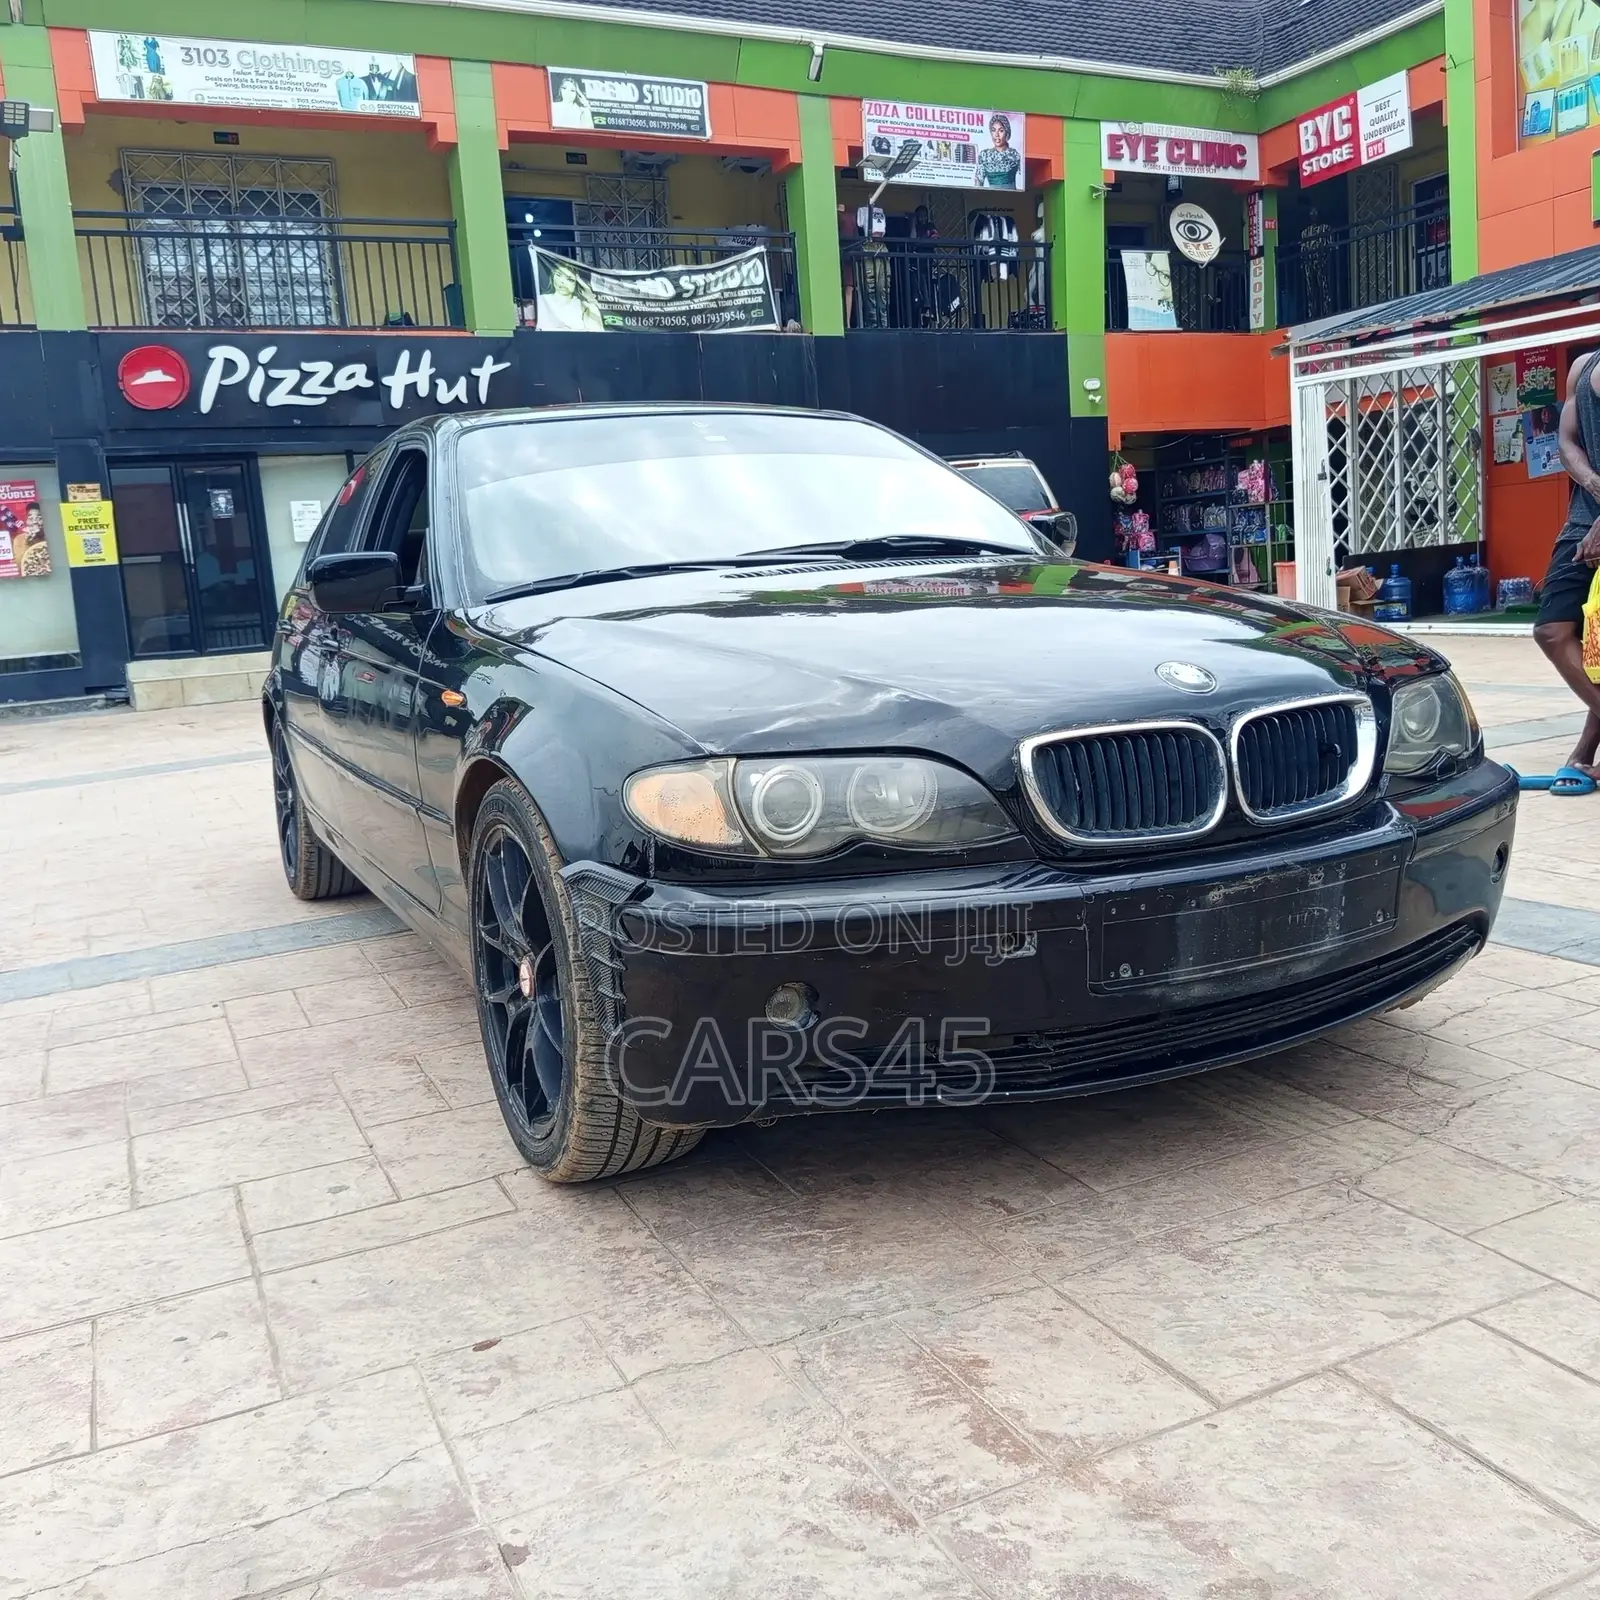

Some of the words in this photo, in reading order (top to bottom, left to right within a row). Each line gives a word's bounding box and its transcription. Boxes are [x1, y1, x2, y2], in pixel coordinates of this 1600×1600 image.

[180, 47, 231, 65] 3103
[236, 50, 344, 78] Clothings
[204, 75, 223, 83] Deals
[214, 81, 240, 90] Sewing,
[241, 83, 268, 91] Bespoke
[642, 84, 702, 108] STUDIO
[866, 102, 900, 119] ZOZA
[906, 106, 985, 127] COLLECTION
[1374, 99, 1391, 113] BEST
[607, 117, 649, 129] 08168730505,
[649, 120, 688, 131] 08179379546
[1369, 108, 1399, 127] QUALITY
[1299, 105, 1352, 156] BYC
[1363, 118, 1406, 141] UNDERWEAR
[1107, 133, 1159, 163] EYE
[1166, 137, 1248, 169] CLINIC
[1367, 142, 1384, 158] BYC
[1302, 143, 1354, 177] STORE
[1182, 242, 1214, 251] EYE
[679, 258, 765, 298] STUDIO
[625, 314, 690, 327] 08168730505,
[691, 310, 746, 325] 08179379546
[200, 345, 373, 414] Pizza
[381, 349, 511, 409] Hut
[72, 510, 99, 518] Glovo
[68, 523, 110, 532] DELIVERY
